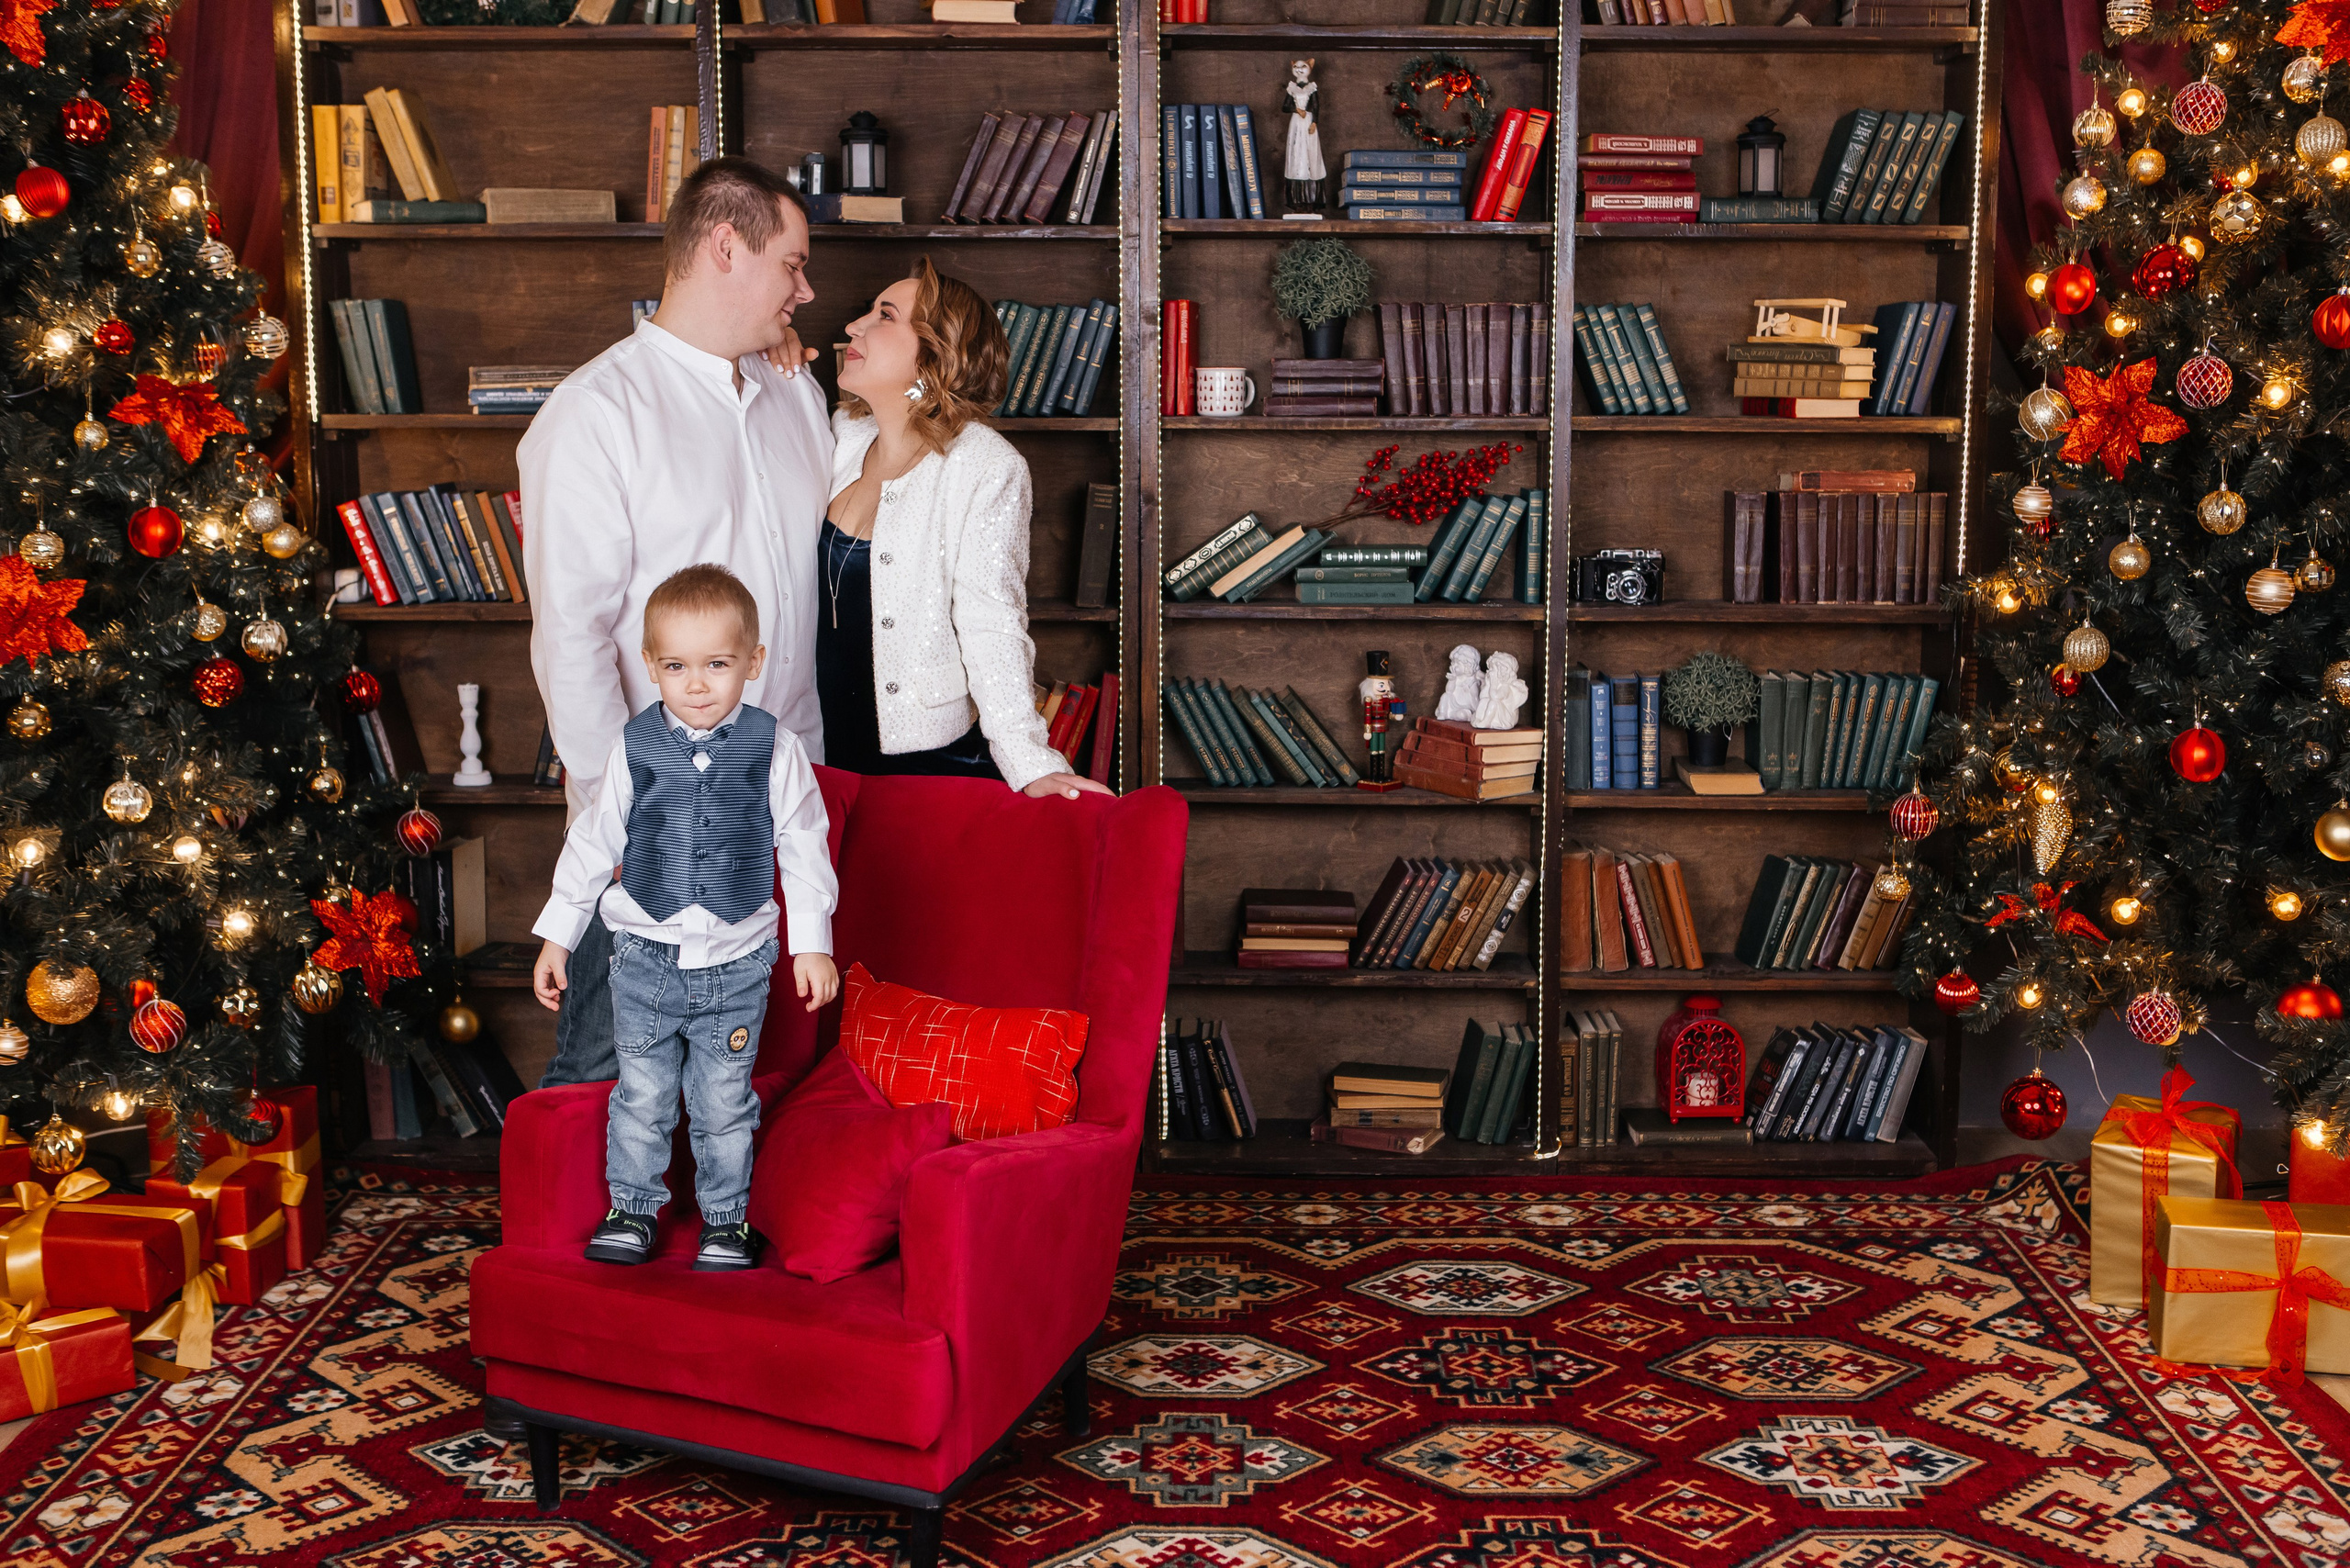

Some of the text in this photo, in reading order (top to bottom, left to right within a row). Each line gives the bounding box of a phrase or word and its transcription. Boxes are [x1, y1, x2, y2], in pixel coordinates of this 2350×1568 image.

[1185, 140, 1194, 171] ШУКШИН
[1206, 140, 1215, 171] ШУКШИН
[1495, 148, 1507, 170] ЛЮДИ
[1503, 119, 1516, 144] ОКЕАНА
[1370, 888, 1403, 942] ЭНЦИКЛОПЕДИЯ
[1384, 890, 1417, 945] ЭНЦИКЛОПЕДИЯ
[1397, 890, 1429, 944] ЭНЦИКЛОПЕДИЯ
[1168, 1048, 1179, 1067] АГАТА
[1171, 1067, 1183, 1093] КРИСТИ
[1875, 1086, 1891, 1117] БРАТСТВО
[1887, 1076, 1895, 1086] ПО
[1856, 1079, 1878, 1126] АГАТА КРИСТИ
[623, 1220, 643, 1231] Denim
